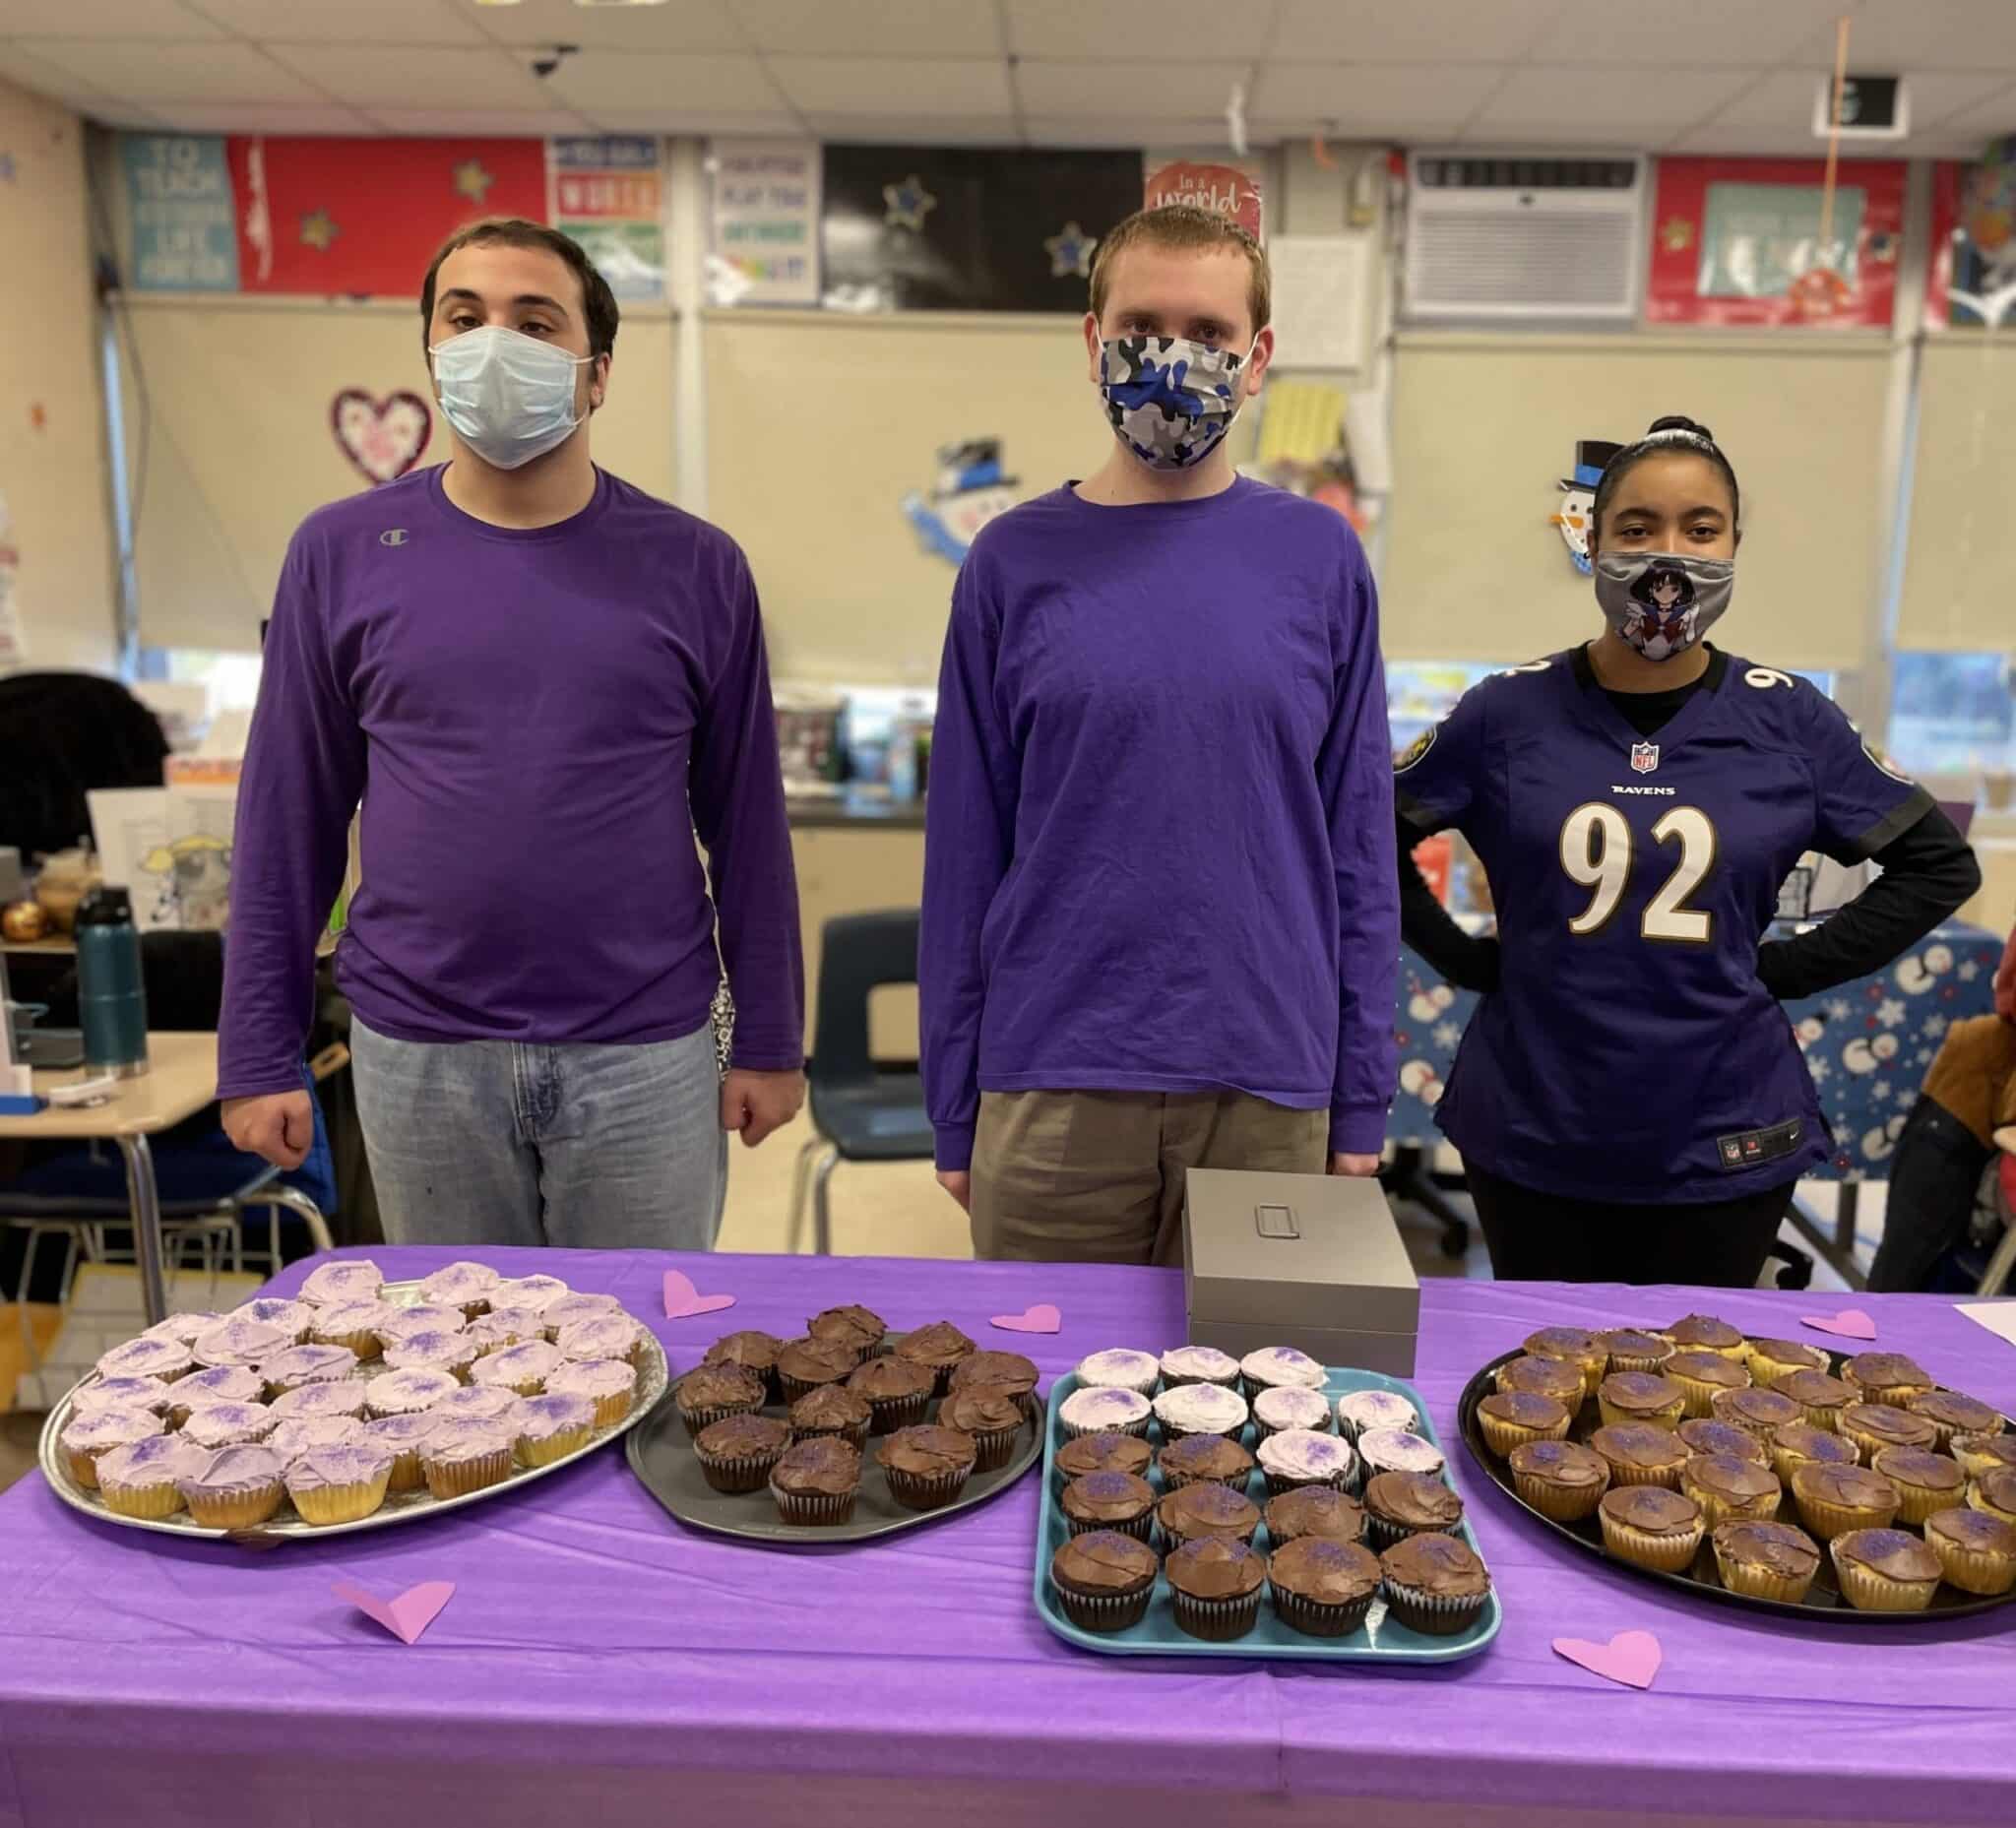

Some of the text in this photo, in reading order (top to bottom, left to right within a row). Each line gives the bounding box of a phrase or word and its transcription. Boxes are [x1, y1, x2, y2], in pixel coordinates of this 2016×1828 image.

[1180, 173, 1194, 190] In
[1156, 182, 1242, 214] world
[1634, 754, 1656, 769] NFL
[1610, 785, 1677, 796] RAVENS
[1559, 801, 1716, 942] 92
